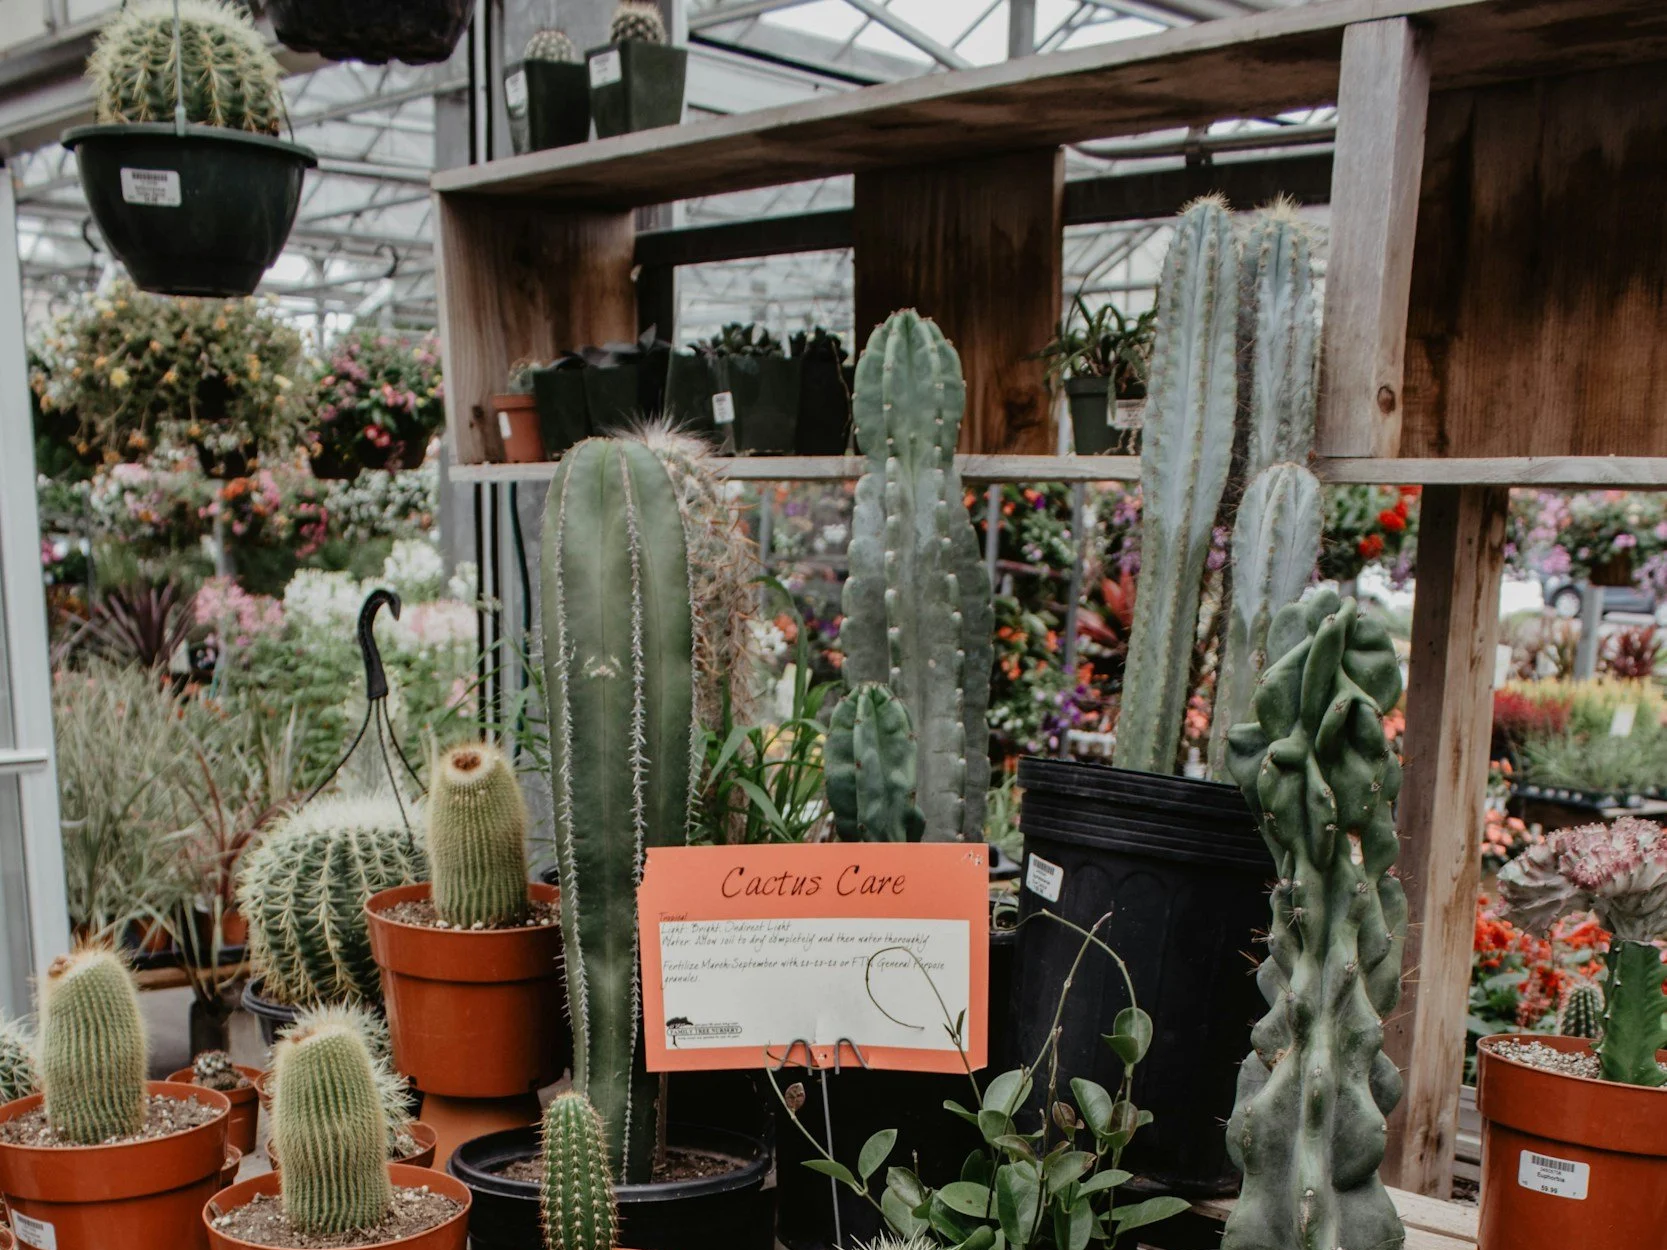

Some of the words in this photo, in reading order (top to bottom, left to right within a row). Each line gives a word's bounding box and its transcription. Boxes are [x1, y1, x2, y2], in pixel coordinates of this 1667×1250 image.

[721, 866, 822, 898] Cactus
[836, 864, 906, 896] Care
[767, 920, 792, 931] Light
[694, 935, 717, 945] Allow
[720, 935, 735, 945] soil
[737, 935, 747, 944] to
[749, 935, 767, 953] dry
[768, 933, 816, 952] completely
[817, 933, 833, 943] and
[837, 933, 855, 943] then
[858, 934, 882, 943] water
[884, 933, 930, 952] thoroughly
[663, 960, 699, 970] Fertilize
[781, 958, 797, 968] with
[839, 960, 849, 968] or
[877, 957, 911, 972] General
[913, 957, 945, 971] Purpose
[670, 1028, 693, 1036] FAMILY
[1537, 1172, 1565, 1183] Euphorbia
[1541, 1185, 1558, 1193] 59.99
